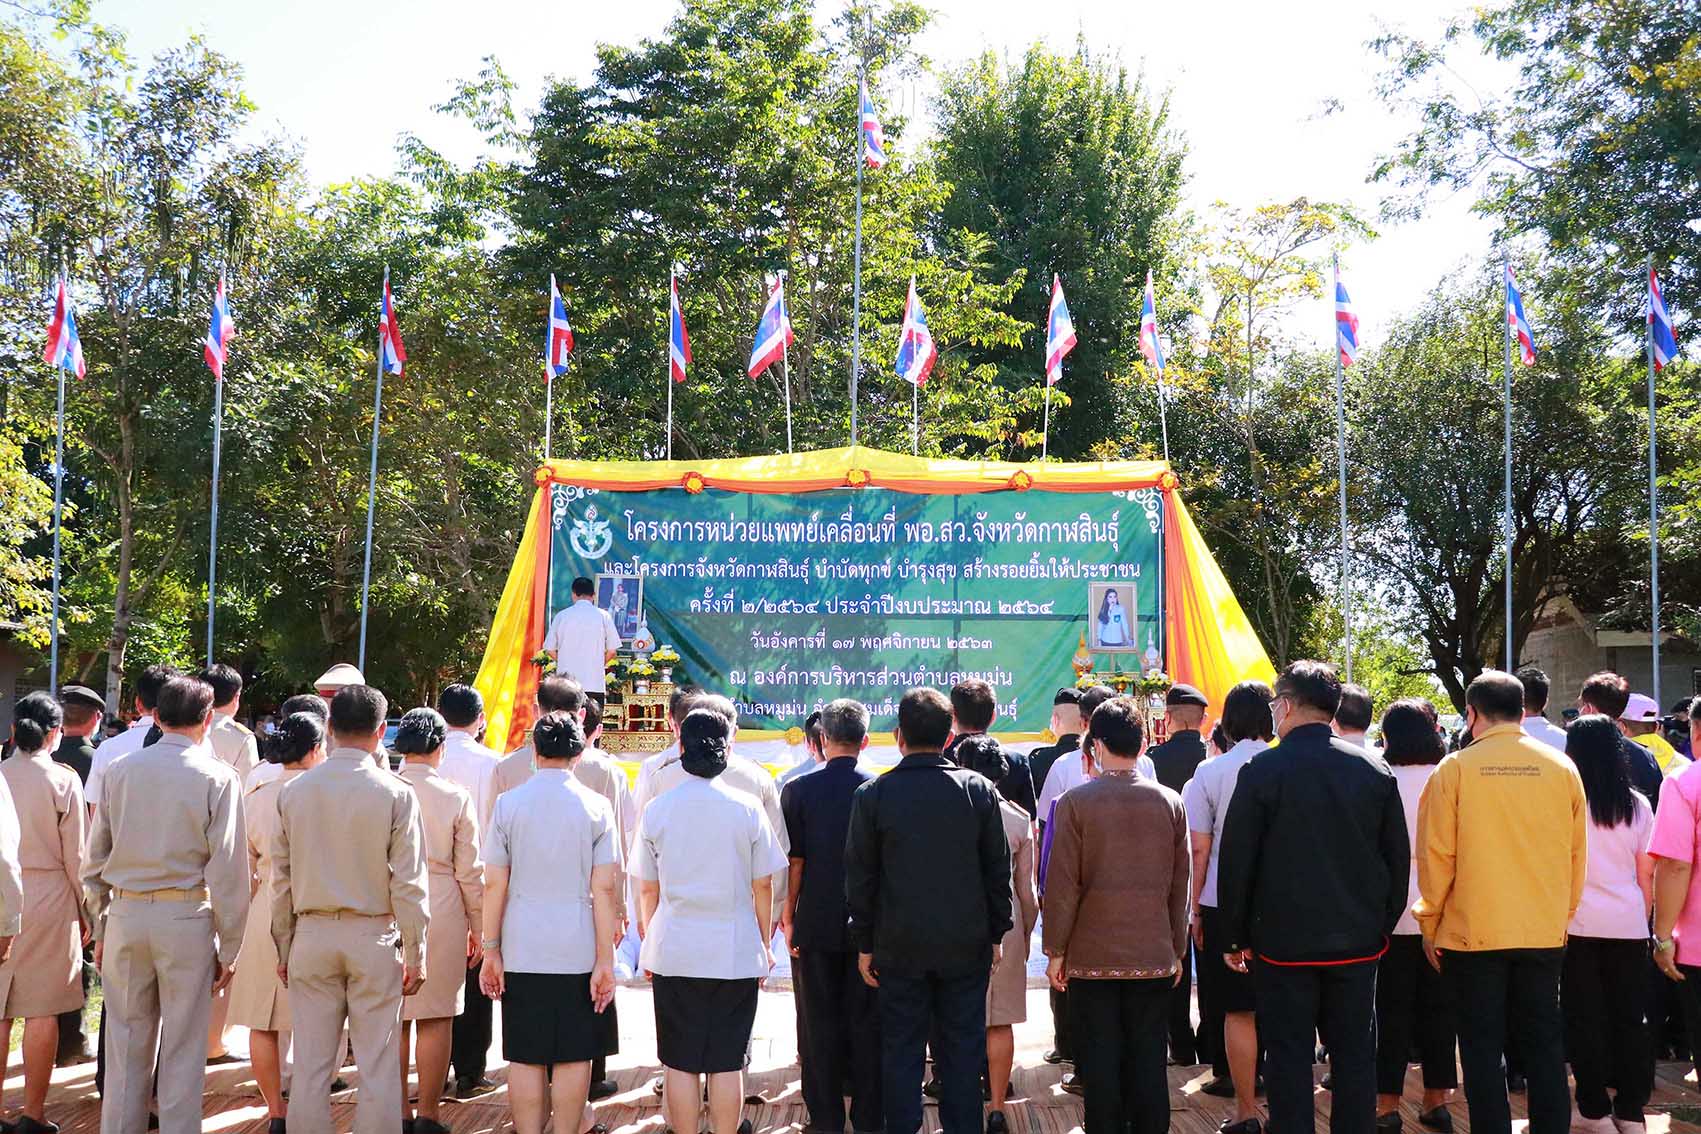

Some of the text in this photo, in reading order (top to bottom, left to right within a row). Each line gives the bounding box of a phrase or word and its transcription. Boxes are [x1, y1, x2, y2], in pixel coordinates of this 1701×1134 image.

[624, 506, 1120, 552] โครงการหน่วยแพทย์เคลื่อนที่ พอ.สว.จังหวัดกาฬสินธุ์
[604, 552, 1141, 584] และโครงการจังหวัดกาฬสินธุ์ บำบัดทุกข์ บำรุงสุข สร้างรอยยิ้มให้ประชาชน
[690, 586, 1054, 615] ครั้งที่ ๒/๒๕๖๔ ประจำปีงบประมาณ ๒๕๖๔
[750, 628, 993, 651] วันอังคารที่ ๑๗ พฤศจิกายน ๒๕๖๓
[729, 670, 746, 685] ณ
